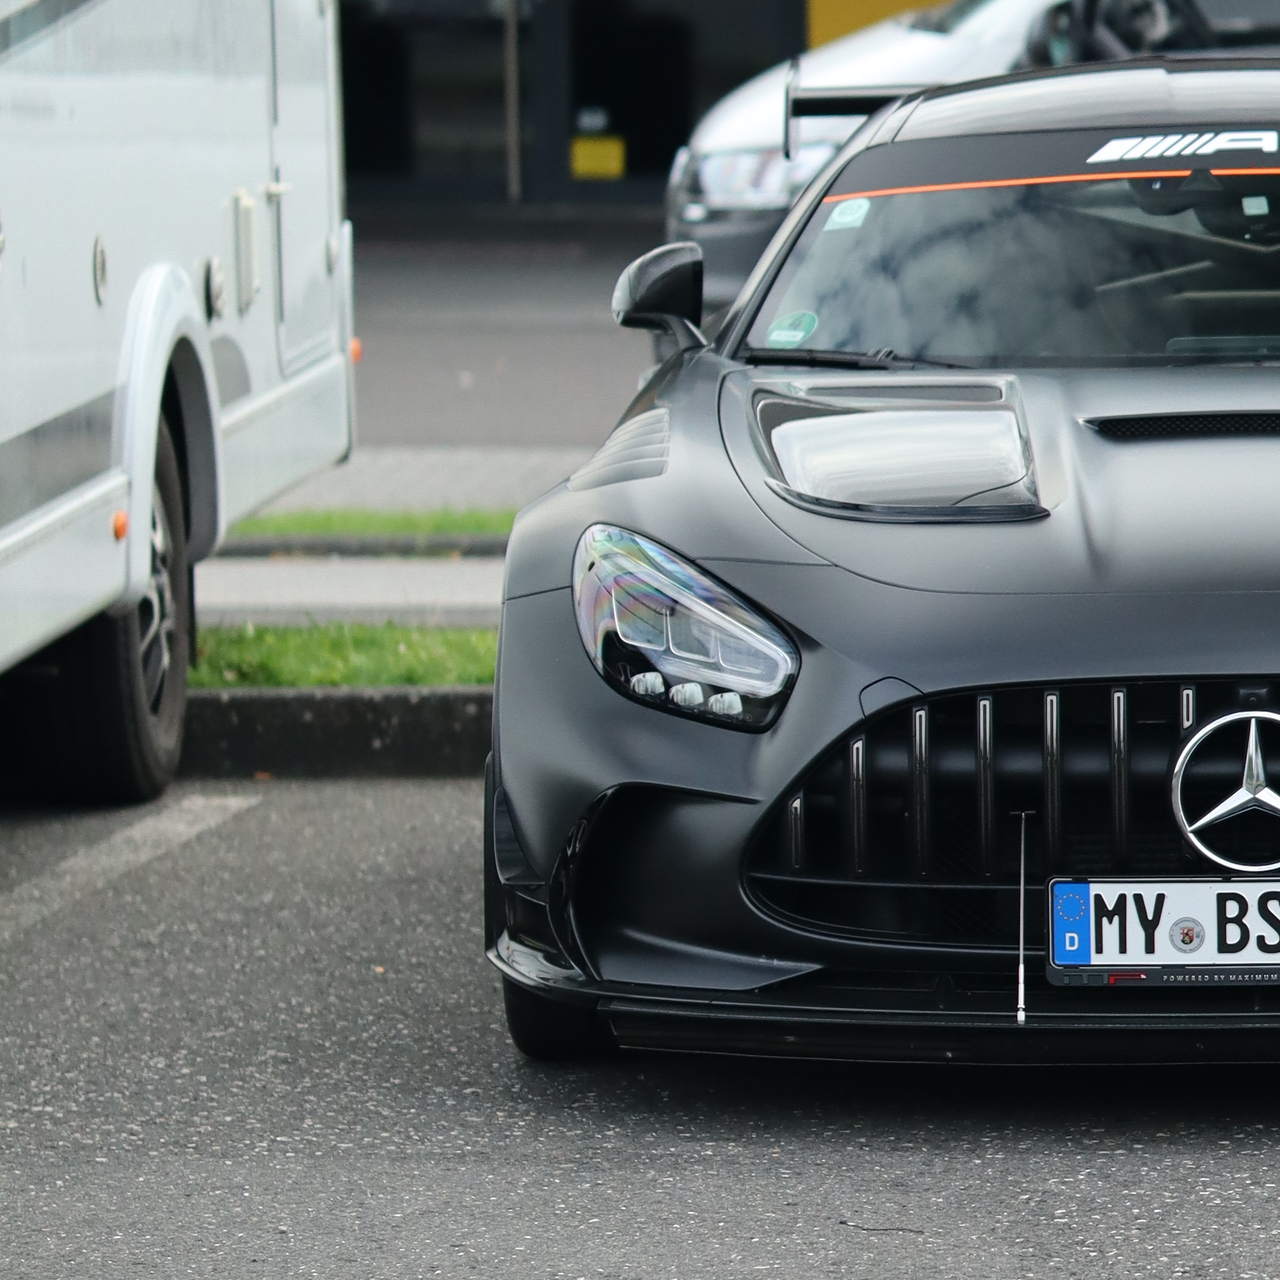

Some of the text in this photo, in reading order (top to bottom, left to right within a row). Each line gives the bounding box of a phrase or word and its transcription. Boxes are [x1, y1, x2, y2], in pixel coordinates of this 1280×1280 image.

[1065, 933, 1079, 950] D
[1093, 893, 1166, 954] MY
[1163, 975, 1211, 983] POWERED
[1214, 975, 1226, 983] BY
[1229, 974, 1279, 982] MAXIMUM
